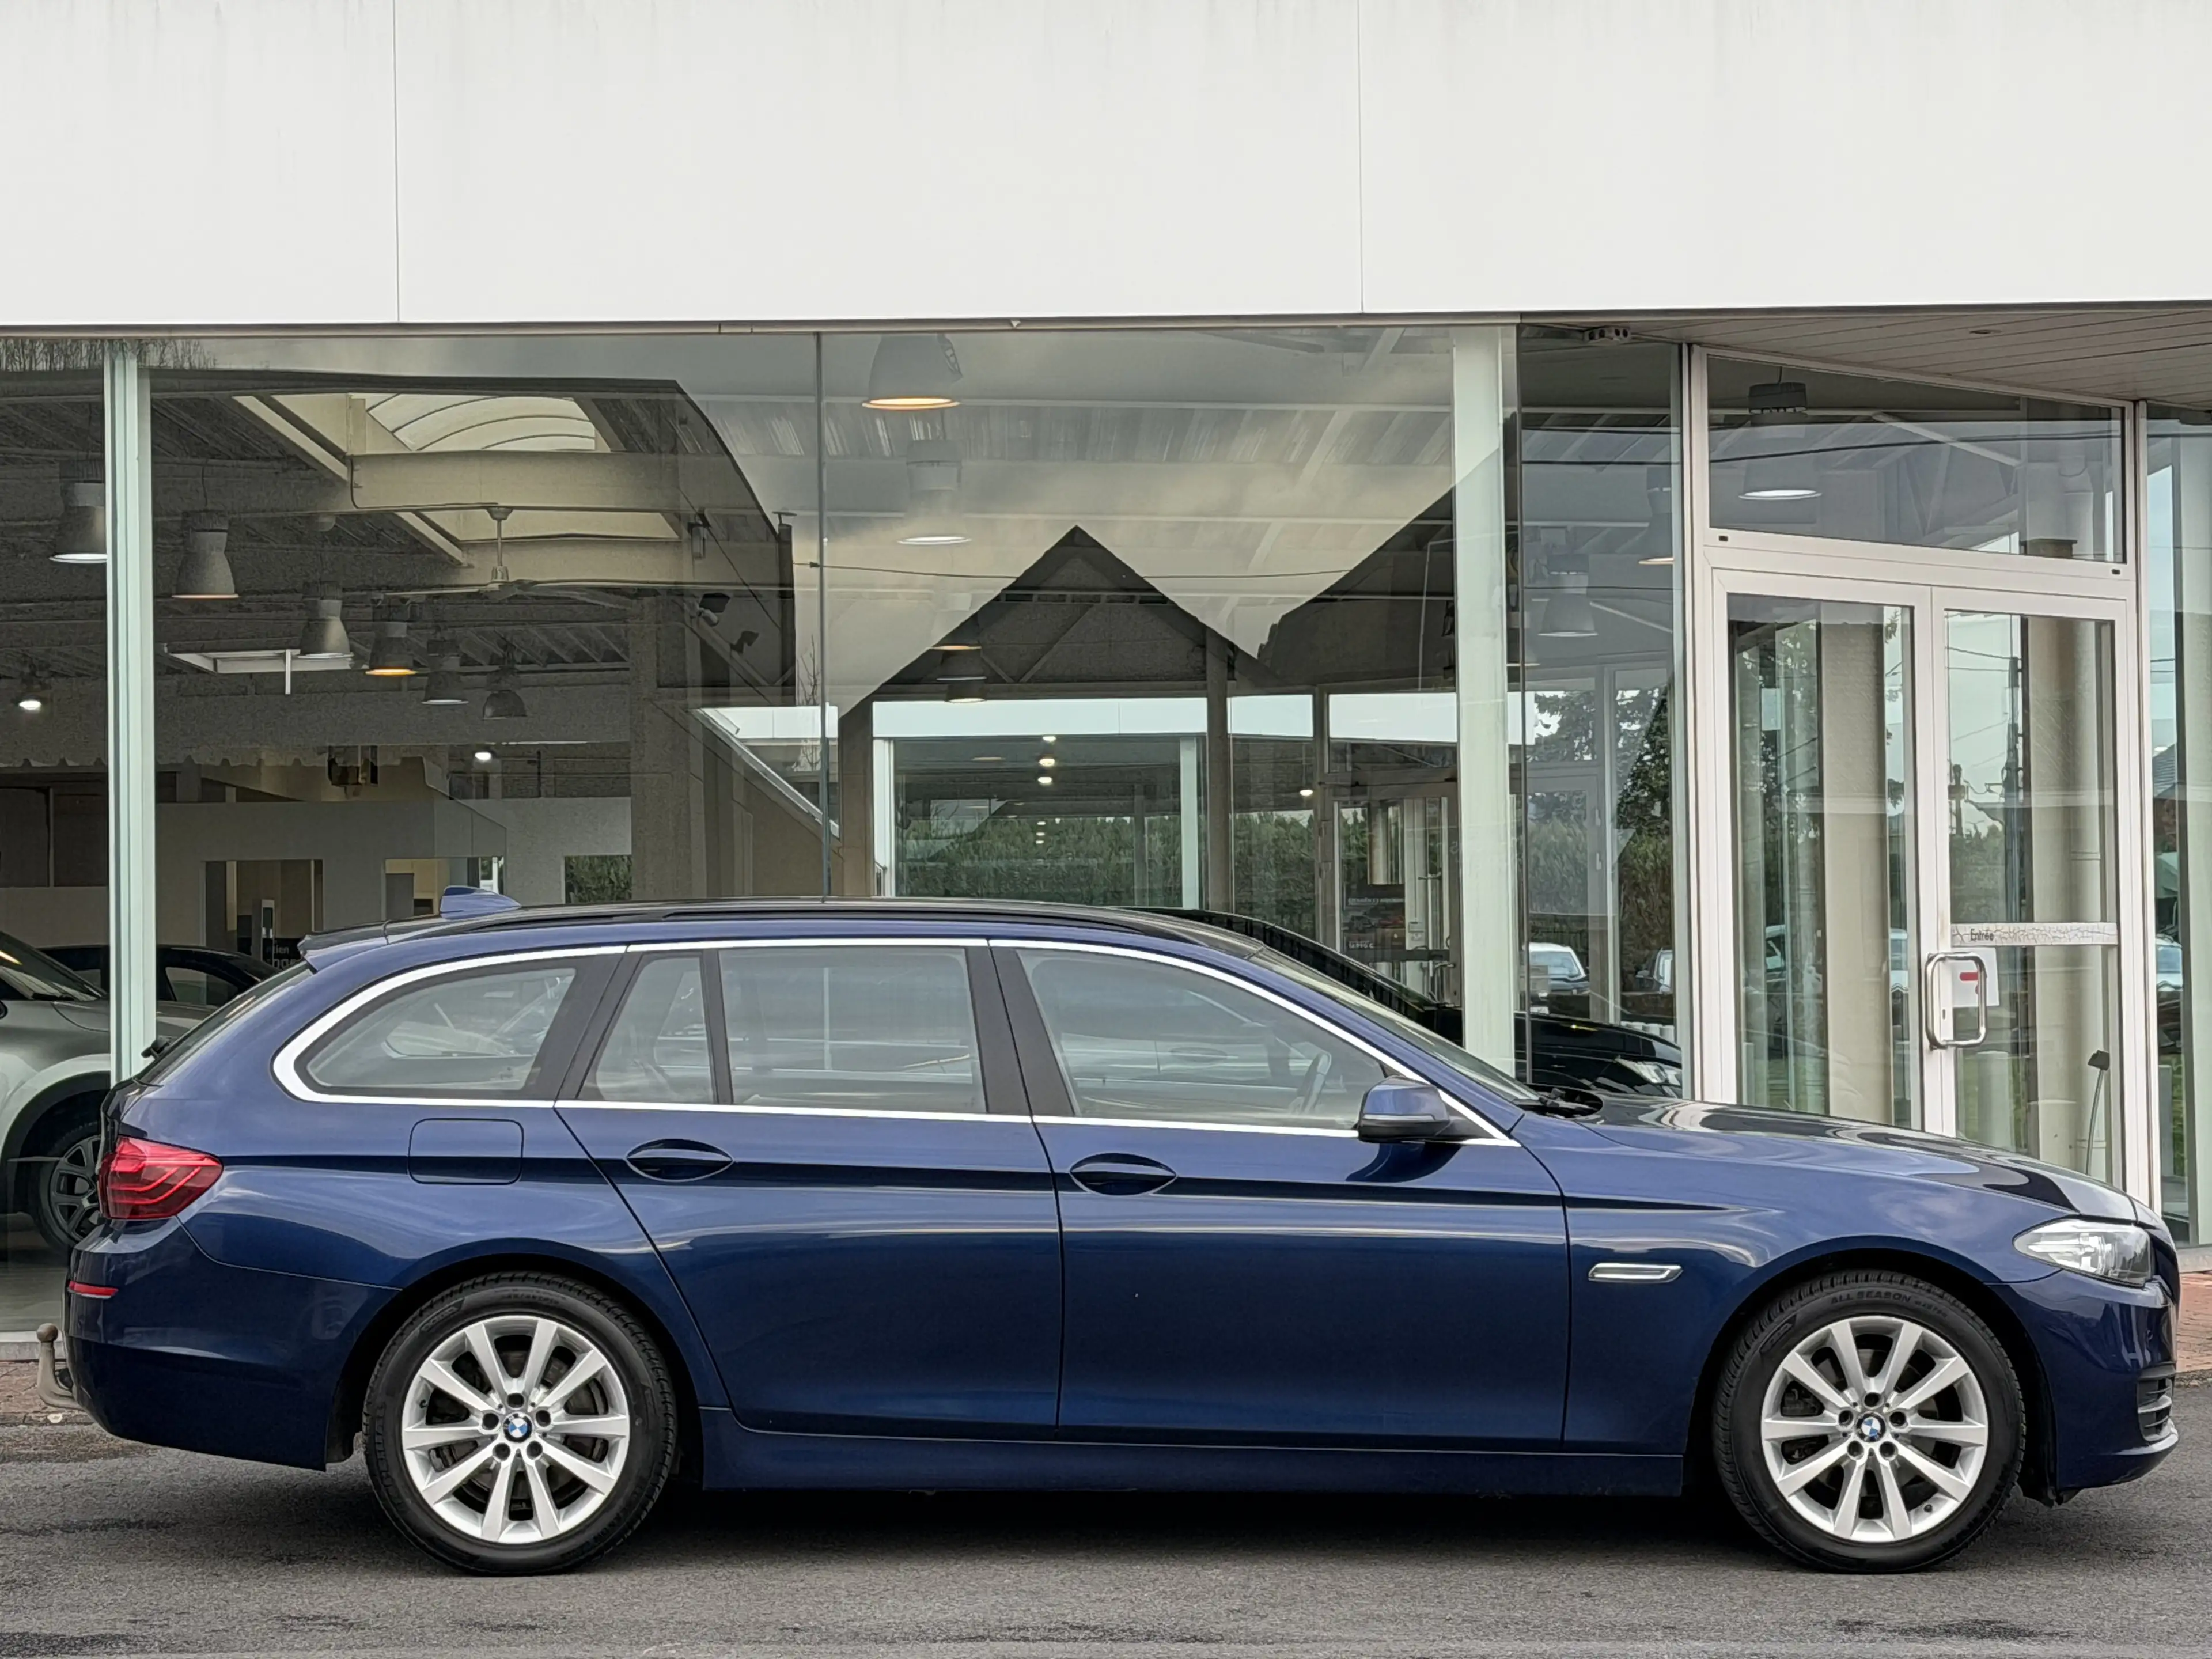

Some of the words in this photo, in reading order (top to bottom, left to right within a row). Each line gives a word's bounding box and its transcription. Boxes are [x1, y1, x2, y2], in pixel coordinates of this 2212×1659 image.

[1970, 928, 1994, 941] Entrée
[1831, 1293, 1853, 1304] ALL
[1857, 1290, 1911, 1303] SEASON
